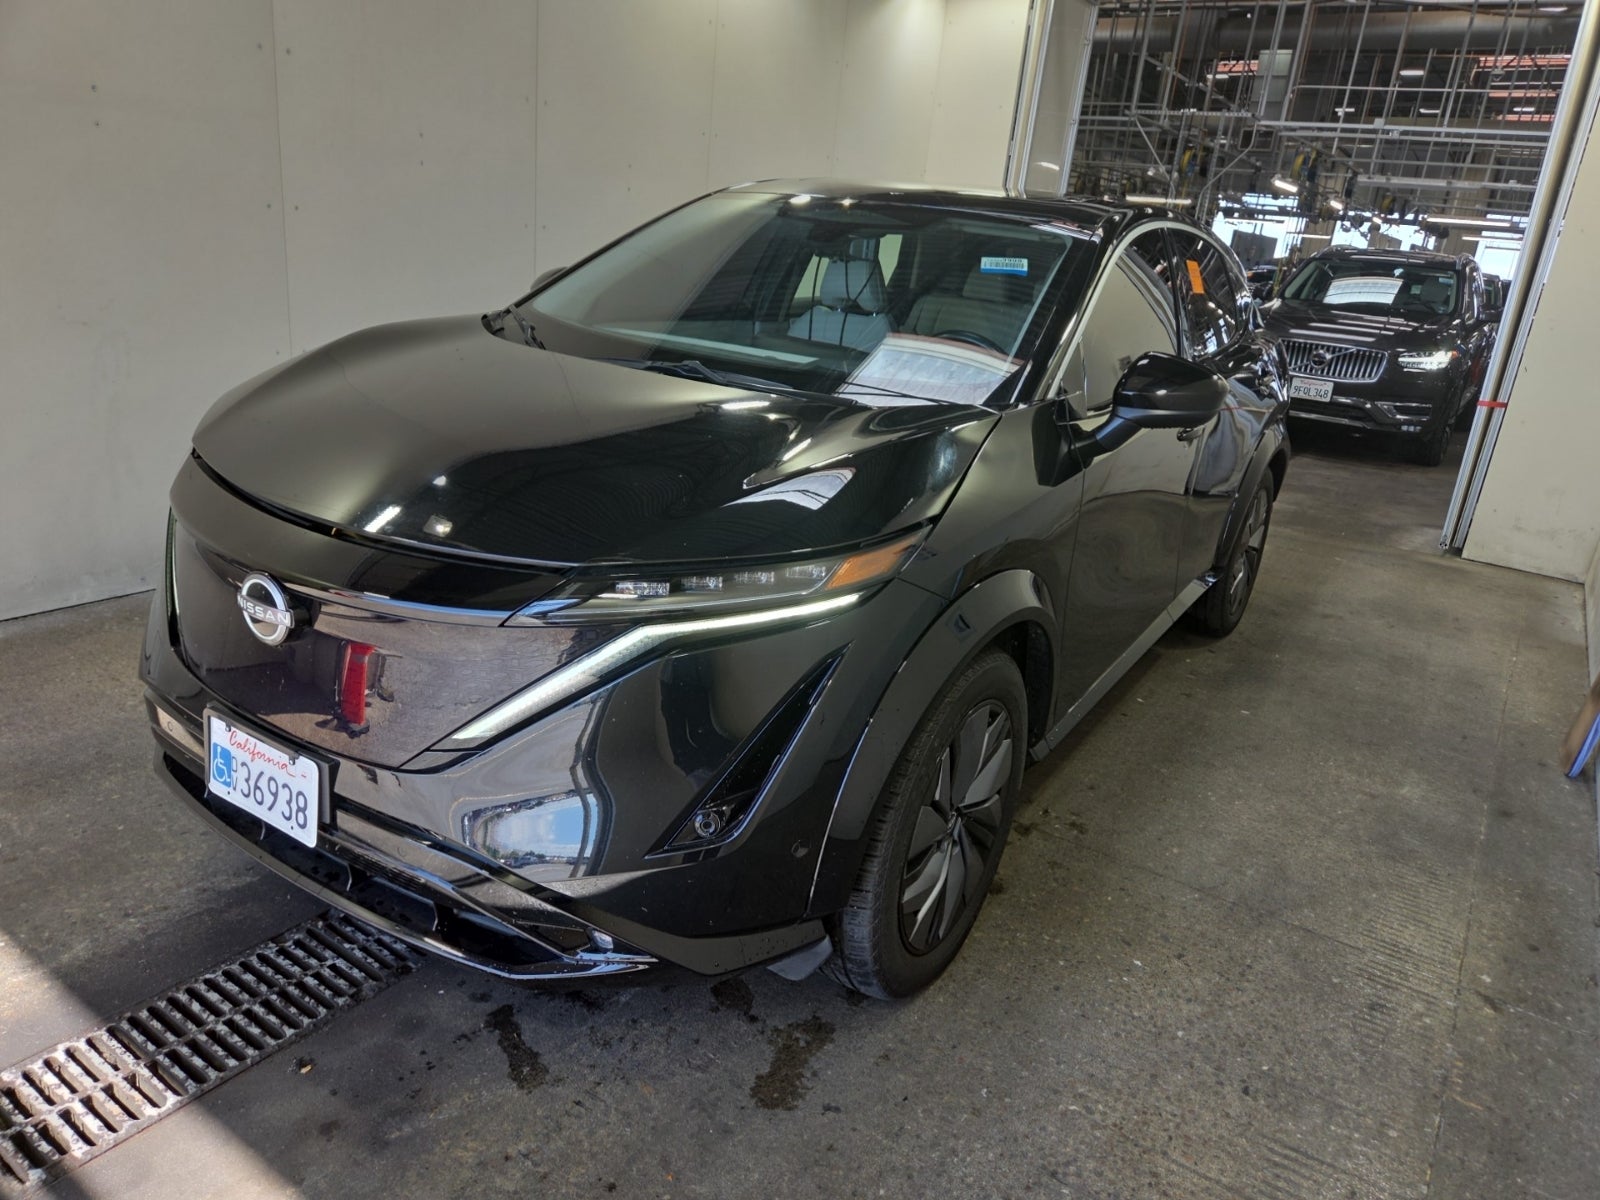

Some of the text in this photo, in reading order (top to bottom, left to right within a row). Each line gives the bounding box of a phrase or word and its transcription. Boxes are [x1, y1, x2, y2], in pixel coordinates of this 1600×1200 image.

[1293, 385, 1329, 399] 9FQL348
[237, 594, 291, 627] NISSAN
[229, 730, 296, 777] California
[240, 761, 308, 830] 36938
